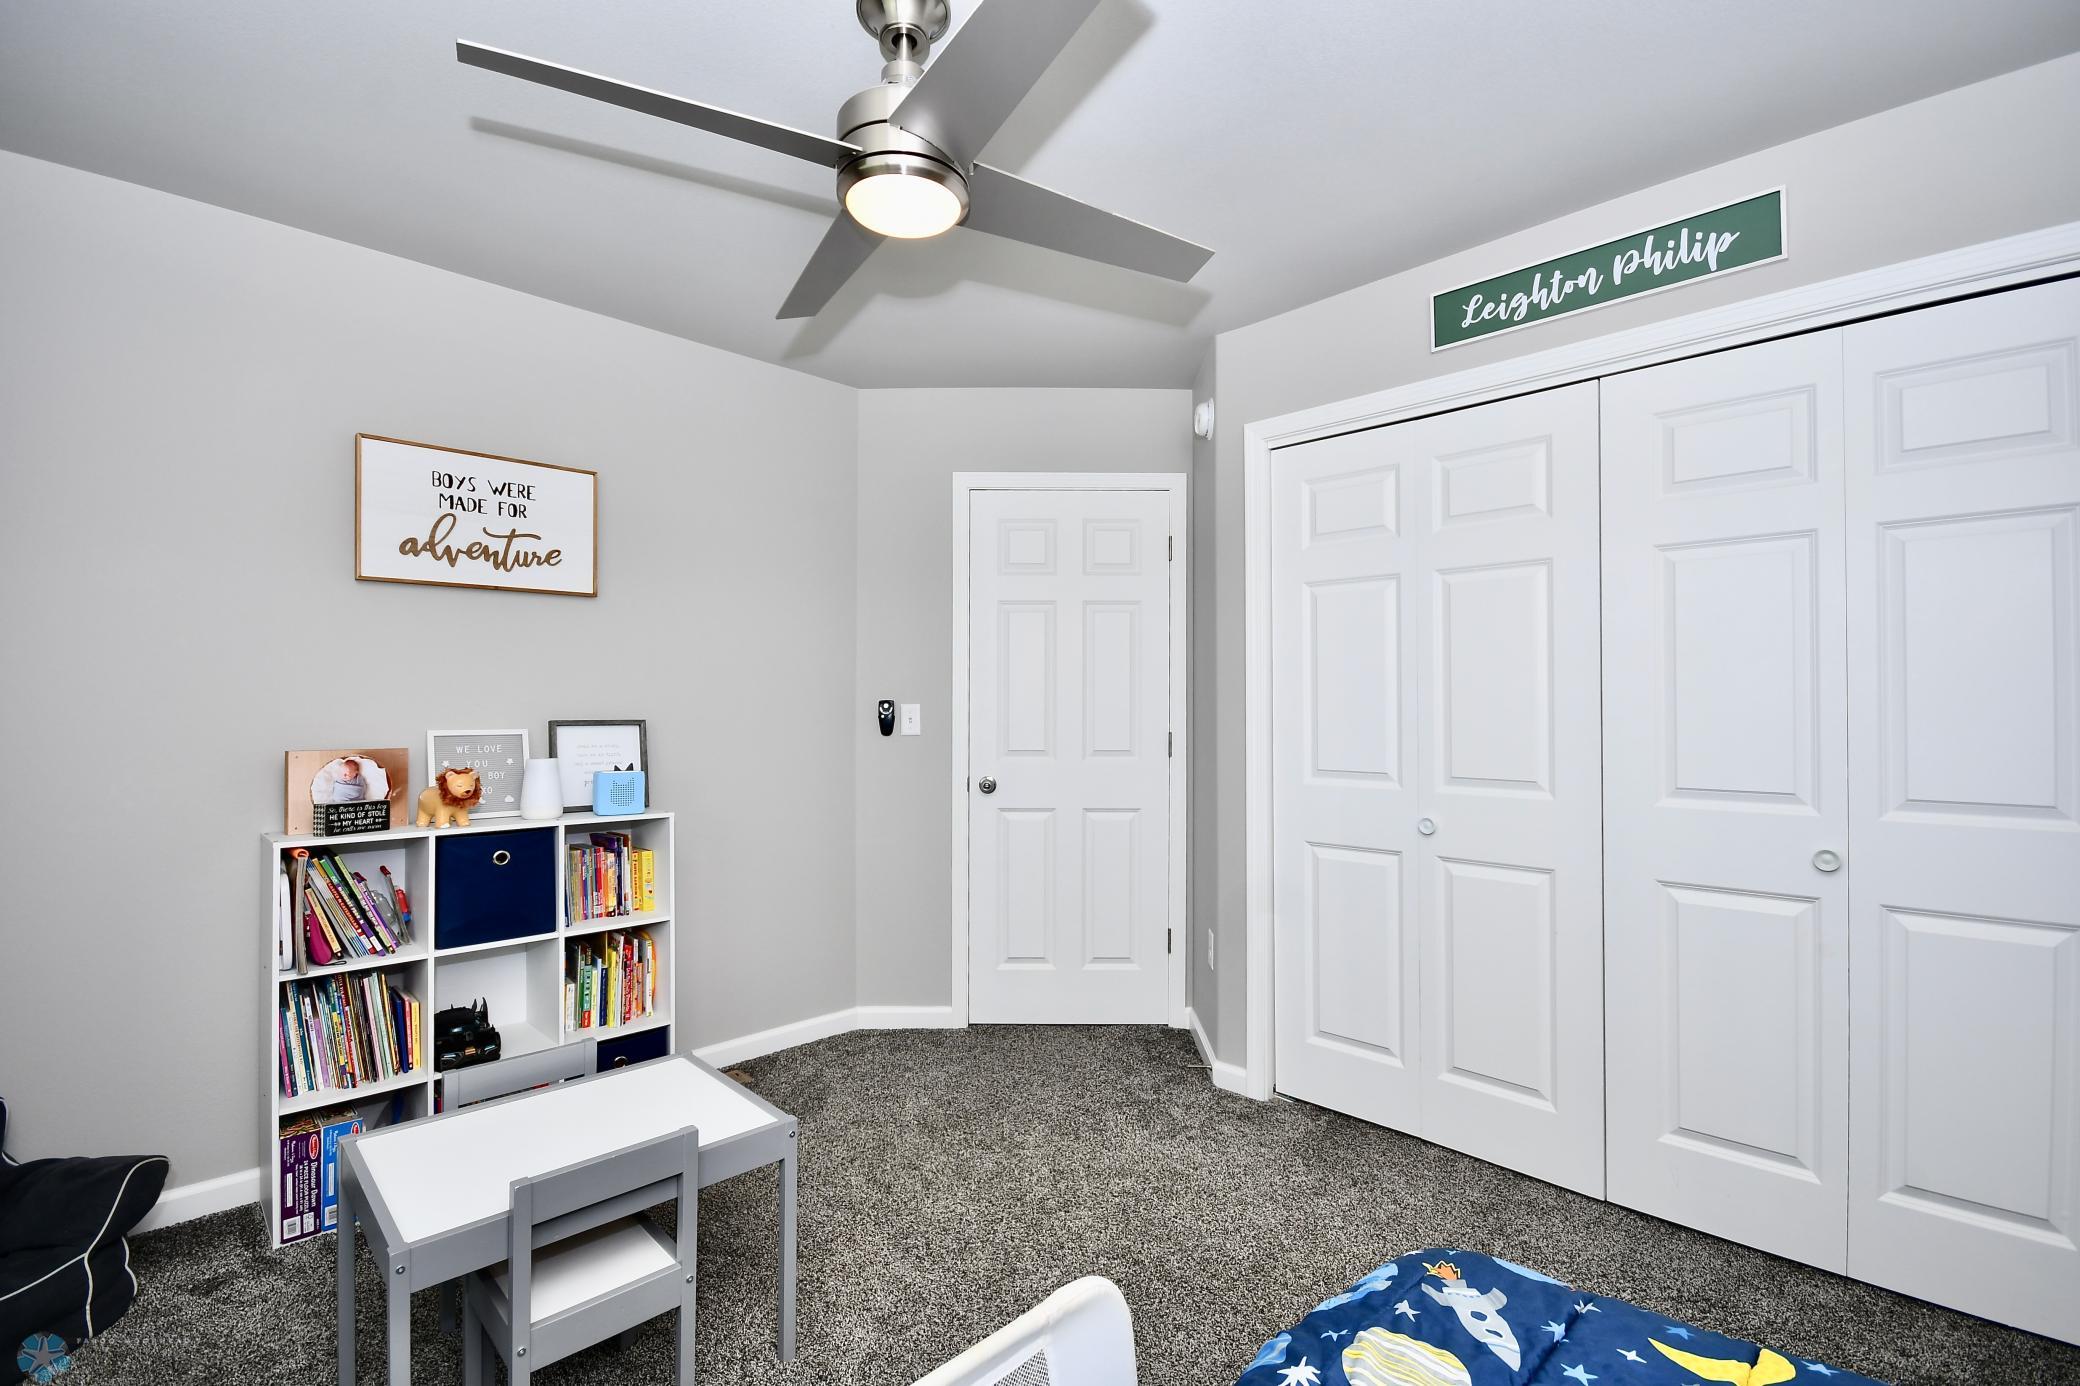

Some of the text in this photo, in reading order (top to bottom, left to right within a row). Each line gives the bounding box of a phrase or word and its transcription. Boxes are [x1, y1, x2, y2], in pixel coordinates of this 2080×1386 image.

[1461, 266, 1605, 328] Leighton
[431, 470, 536, 501] BOYS WERE
[439, 493, 528, 519] MADE FOR
[399, 513, 563, 572] adventure
[455, 744, 502, 754] WE LOVE
[466, 760, 488, 768] YOU
[488, 771, 505, 780] BOY
[367, 809, 386, 817] STOLE
